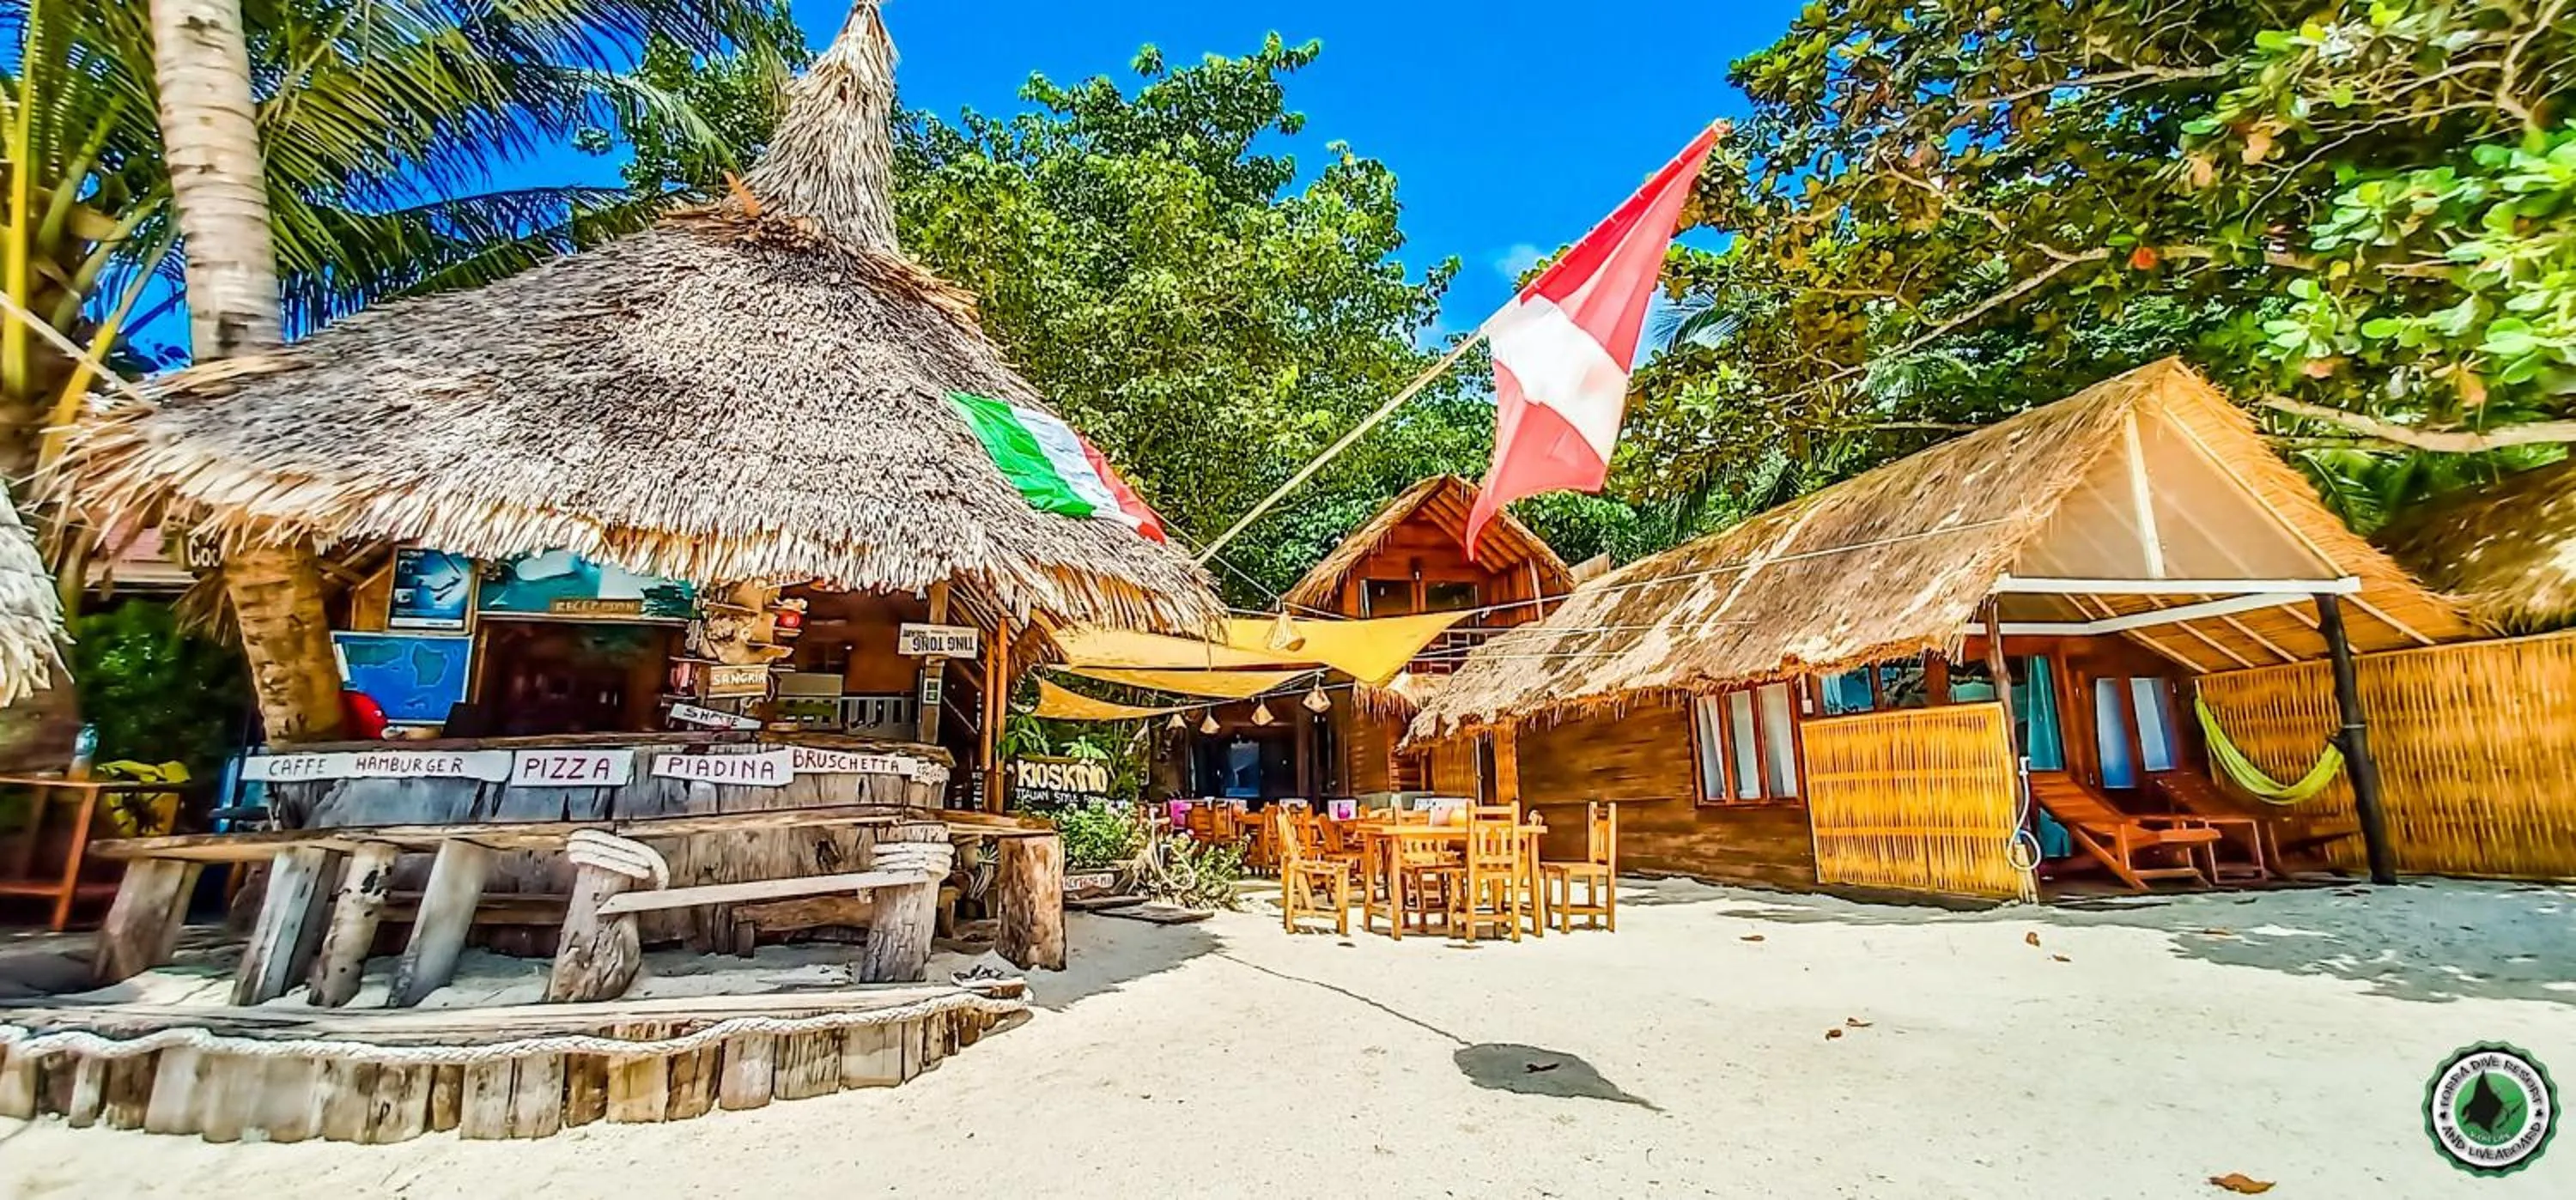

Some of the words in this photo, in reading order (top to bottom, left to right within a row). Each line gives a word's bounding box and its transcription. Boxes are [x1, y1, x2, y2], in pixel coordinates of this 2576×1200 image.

[912, 636, 945, 652] TONG
[947, 636, 975, 652] TING
[713, 672, 767, 686] SANGRIA
[683, 706, 740, 727] SHAE
[269, 757, 327, 777] CAFFE
[355, 756, 464, 773] HAMBURGER
[524, 757, 611, 779] PIZZA
[667, 756, 775, 780] PIADINA
[793, 748, 899, 773] BRUSCHETTA
[1054, 791, 1079, 804] STYLE
